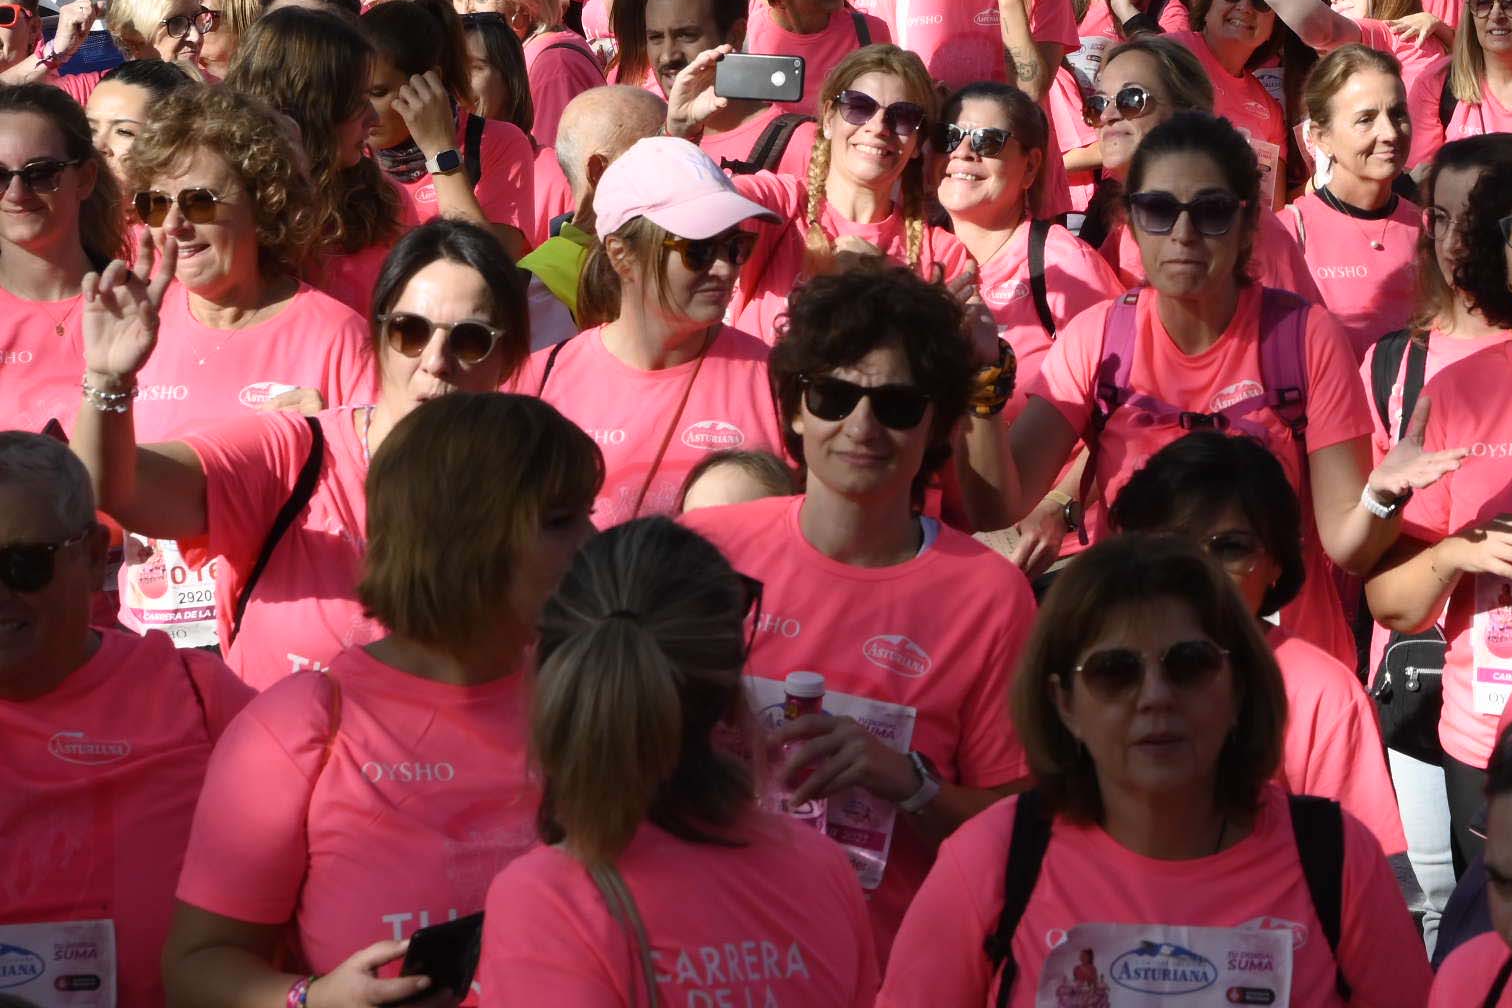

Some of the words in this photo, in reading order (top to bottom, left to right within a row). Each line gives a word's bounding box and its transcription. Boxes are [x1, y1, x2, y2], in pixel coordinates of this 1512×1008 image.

[1316, 266, 1368, 280] OYSHO
[686, 430, 742, 445] ASTURIANA
[178, 589, 213, 604] 2920
[868, 643, 927, 673] ASTURIANA
[362, 761, 454, 783] OYSHO
[650, 940, 809, 985] CARRERA
[1227, 959, 1274, 971] SUMA
[1119, 961, 1210, 984] ASTURIANA
